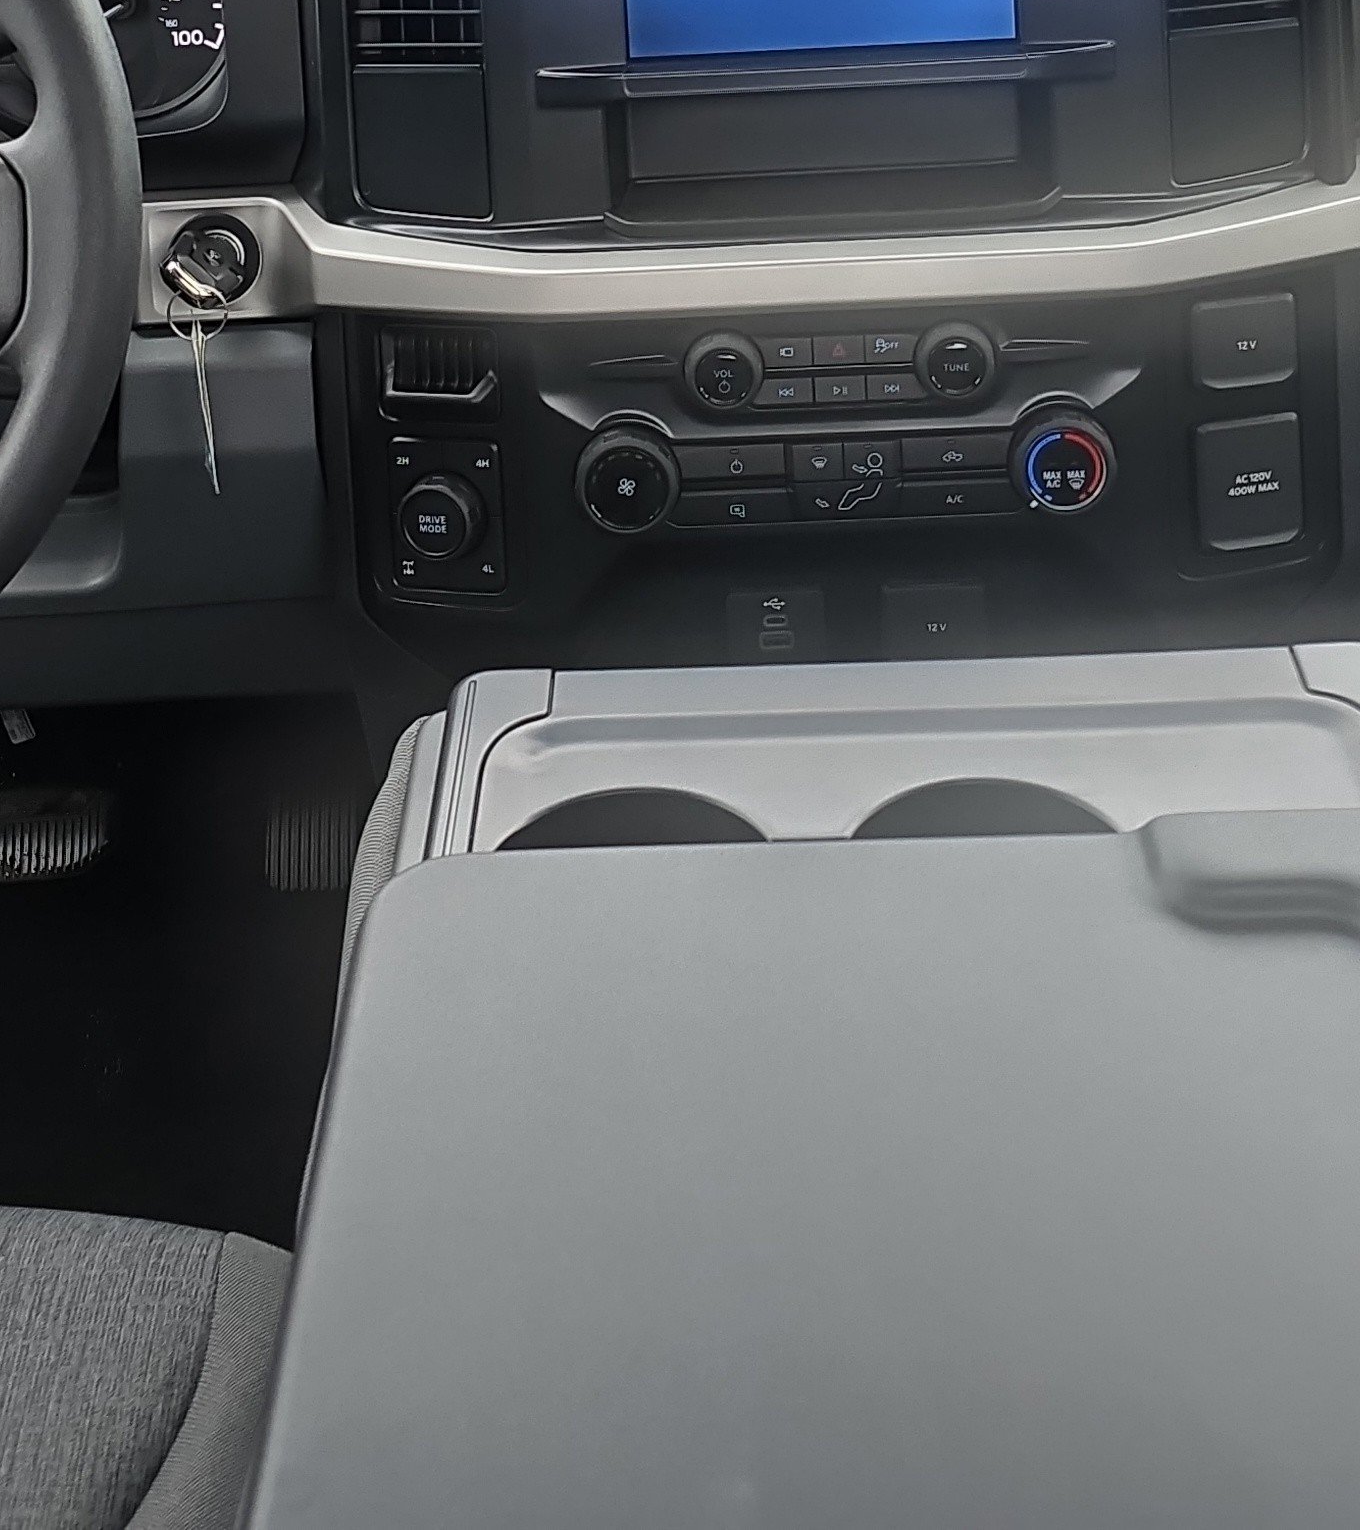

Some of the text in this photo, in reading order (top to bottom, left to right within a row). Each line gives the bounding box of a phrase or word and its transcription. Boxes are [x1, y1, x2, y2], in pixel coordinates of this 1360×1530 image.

[171, 29, 204, 46] 100
[1237, 341, 1248, 351] 12
[943, 362, 970, 372] TUNE
[714, 369, 734, 379] VOL
[396, 457, 410, 465] 2H
[476, 459, 490, 468] 4H
[1043, 470, 1062, 480] MAX
[1066, 469, 1086, 479] MAX
[1235, 470, 1273, 485] AC 120V
[1046, 479, 1061, 488] A/C
[1227, 481, 1280, 497] 400W MAX
[945, 494, 964, 504] A/C
[418, 515, 447, 524] DRIVE
[419, 524, 447, 533] MODE
[482, 564, 495, 573] 4L
[927, 623, 938, 632] 12
